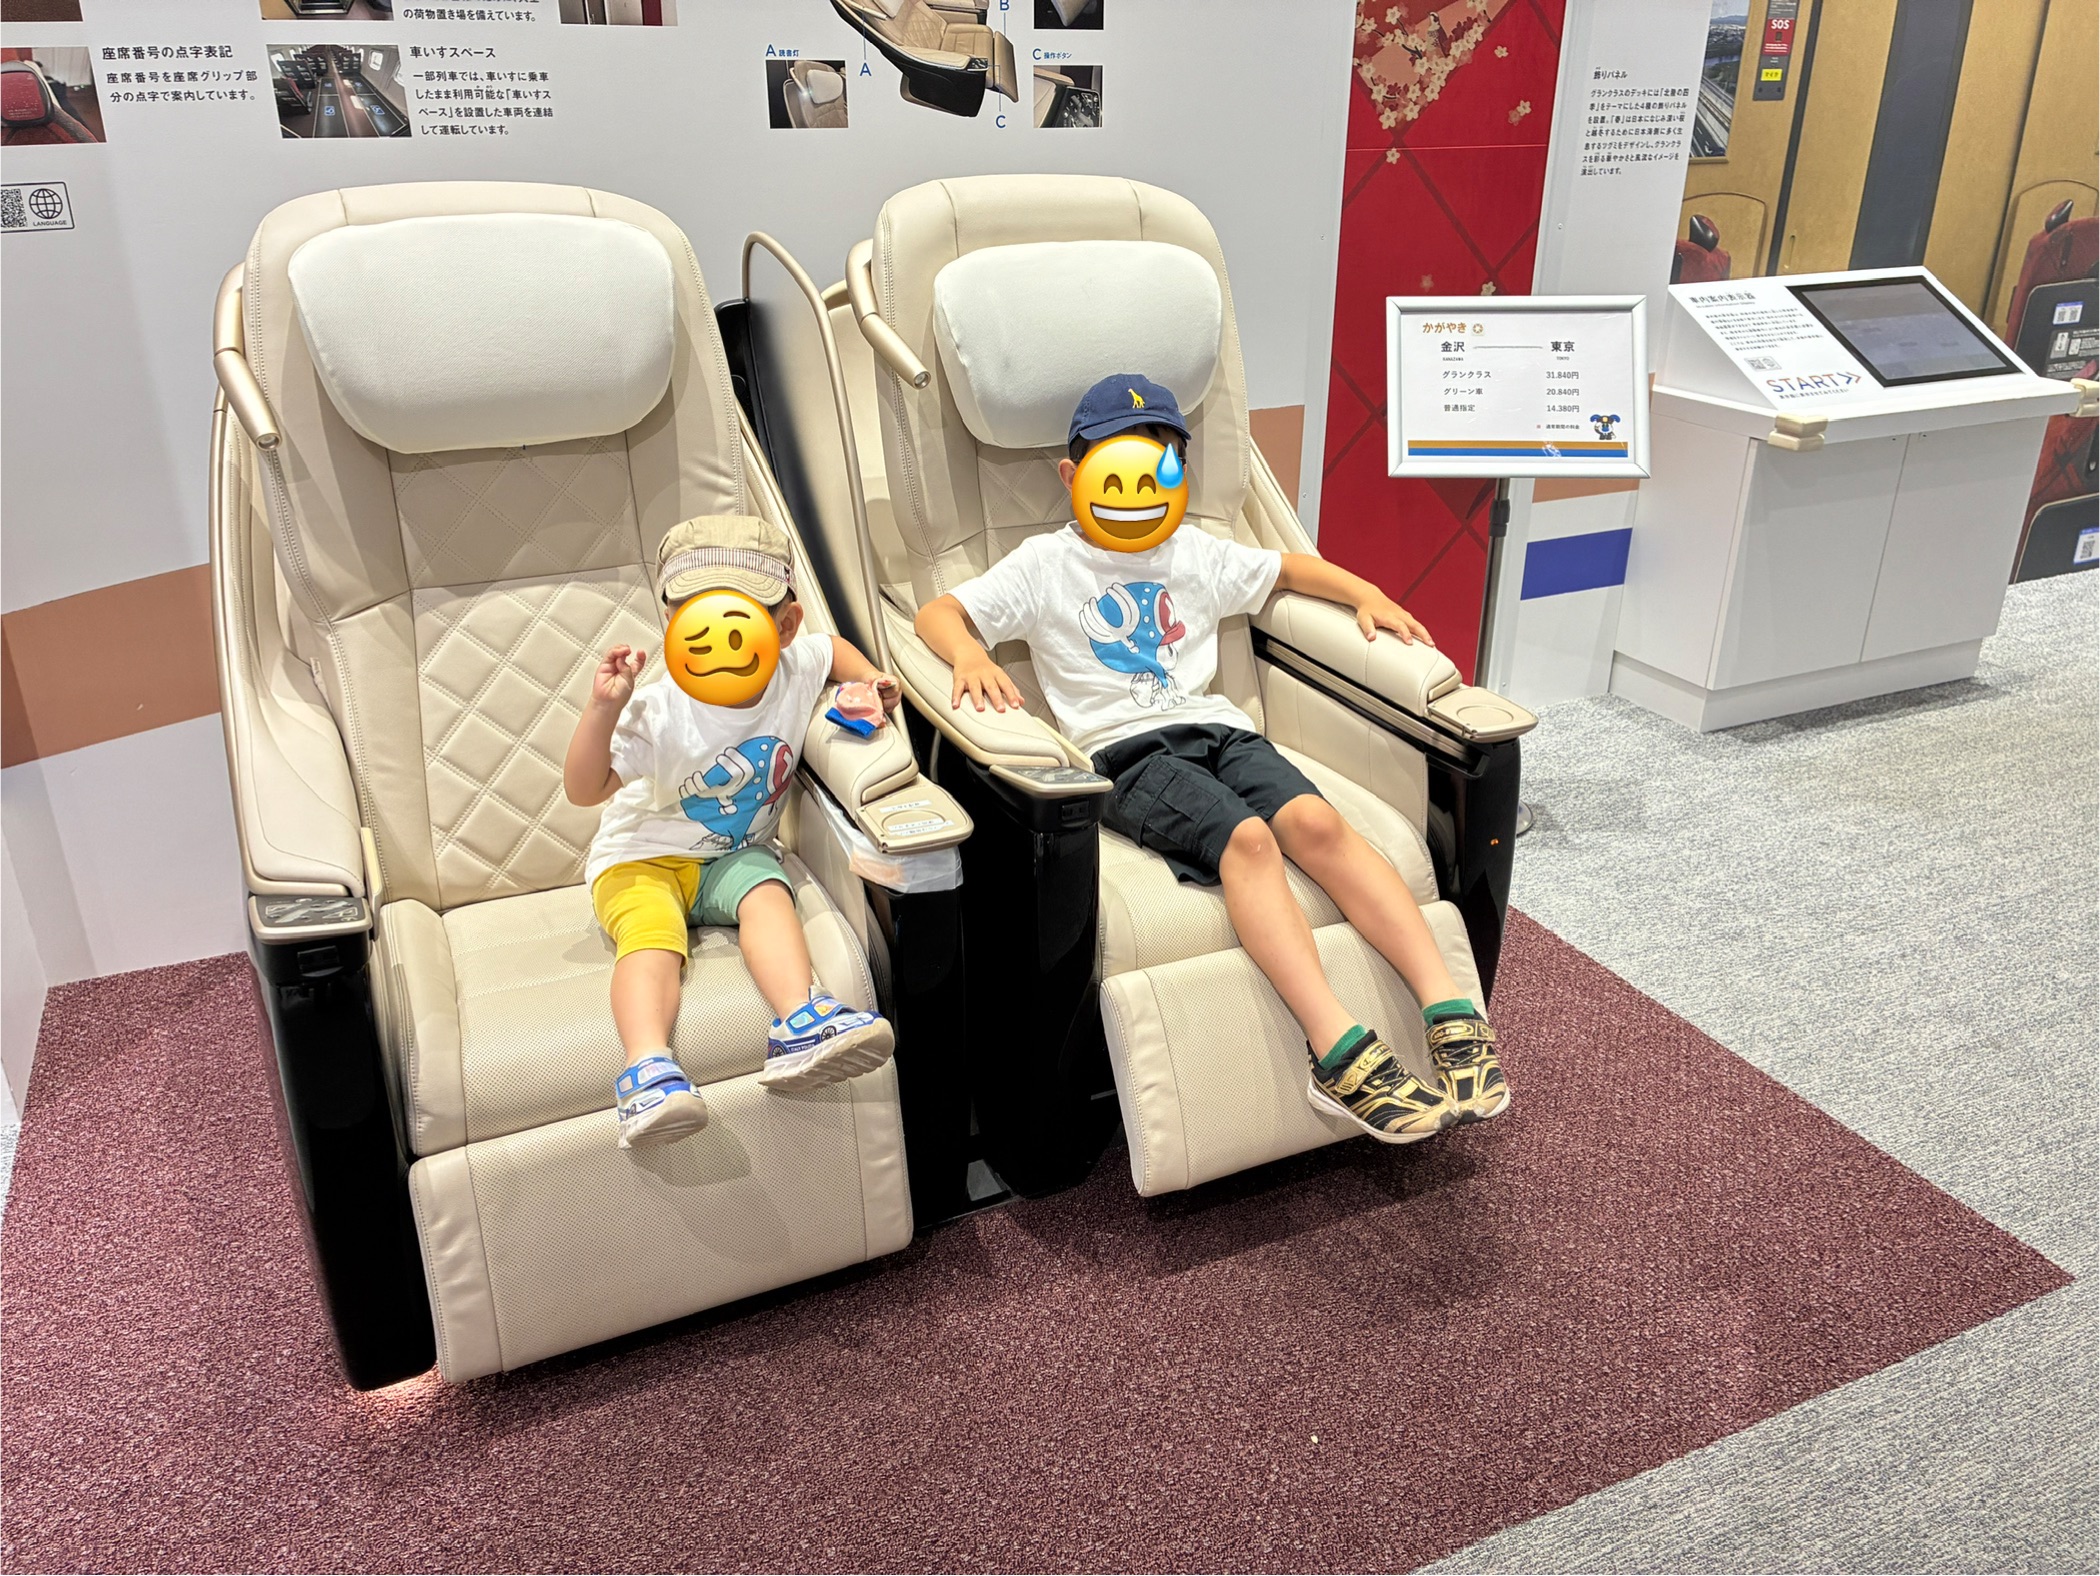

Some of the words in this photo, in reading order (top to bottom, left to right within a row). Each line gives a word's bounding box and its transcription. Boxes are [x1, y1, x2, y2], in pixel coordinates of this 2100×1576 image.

[403, 9, 536, 22] の荷物置き場を備えています。
[1771, 19, 1790, 29] SOS
[102, 45, 233, 60] 座席番号の点字表記
[410, 46, 496, 58] 車いすスペース
[765, 44, 777, 57] A
[1032, 48, 1042, 61] C
[1043, 51, 1072, 60] 操作ボタン
[859, 62, 872, 77] A
[1593, 70, 1628, 80] 飾りパネル
[106, 70, 258, 84] 座席番号を座席グリップ部
[413, 70, 549, 82] 一部列車では、車いすに乗車
[109, 88, 256, 103] 分の点字で案内しています。
[415, 88, 551, 101] したまま利用可能な「車いすス
[418, 106, 554, 118] ペース」を設置した車両を連結
[995, 115, 1006, 129] C
[421, 125, 509, 136] して運転しています。
[1422, 322, 1467, 334] かがやき
[1440, 341, 1465, 352] 金沢
[1551, 341, 1575, 352] 東京
[1442, 370, 1492, 379] グランクラス
[1766, 373, 1839, 393] START
[1443, 387, 1483, 396] グリーン車
[1444, 404, 1476, 413] 普通指定
